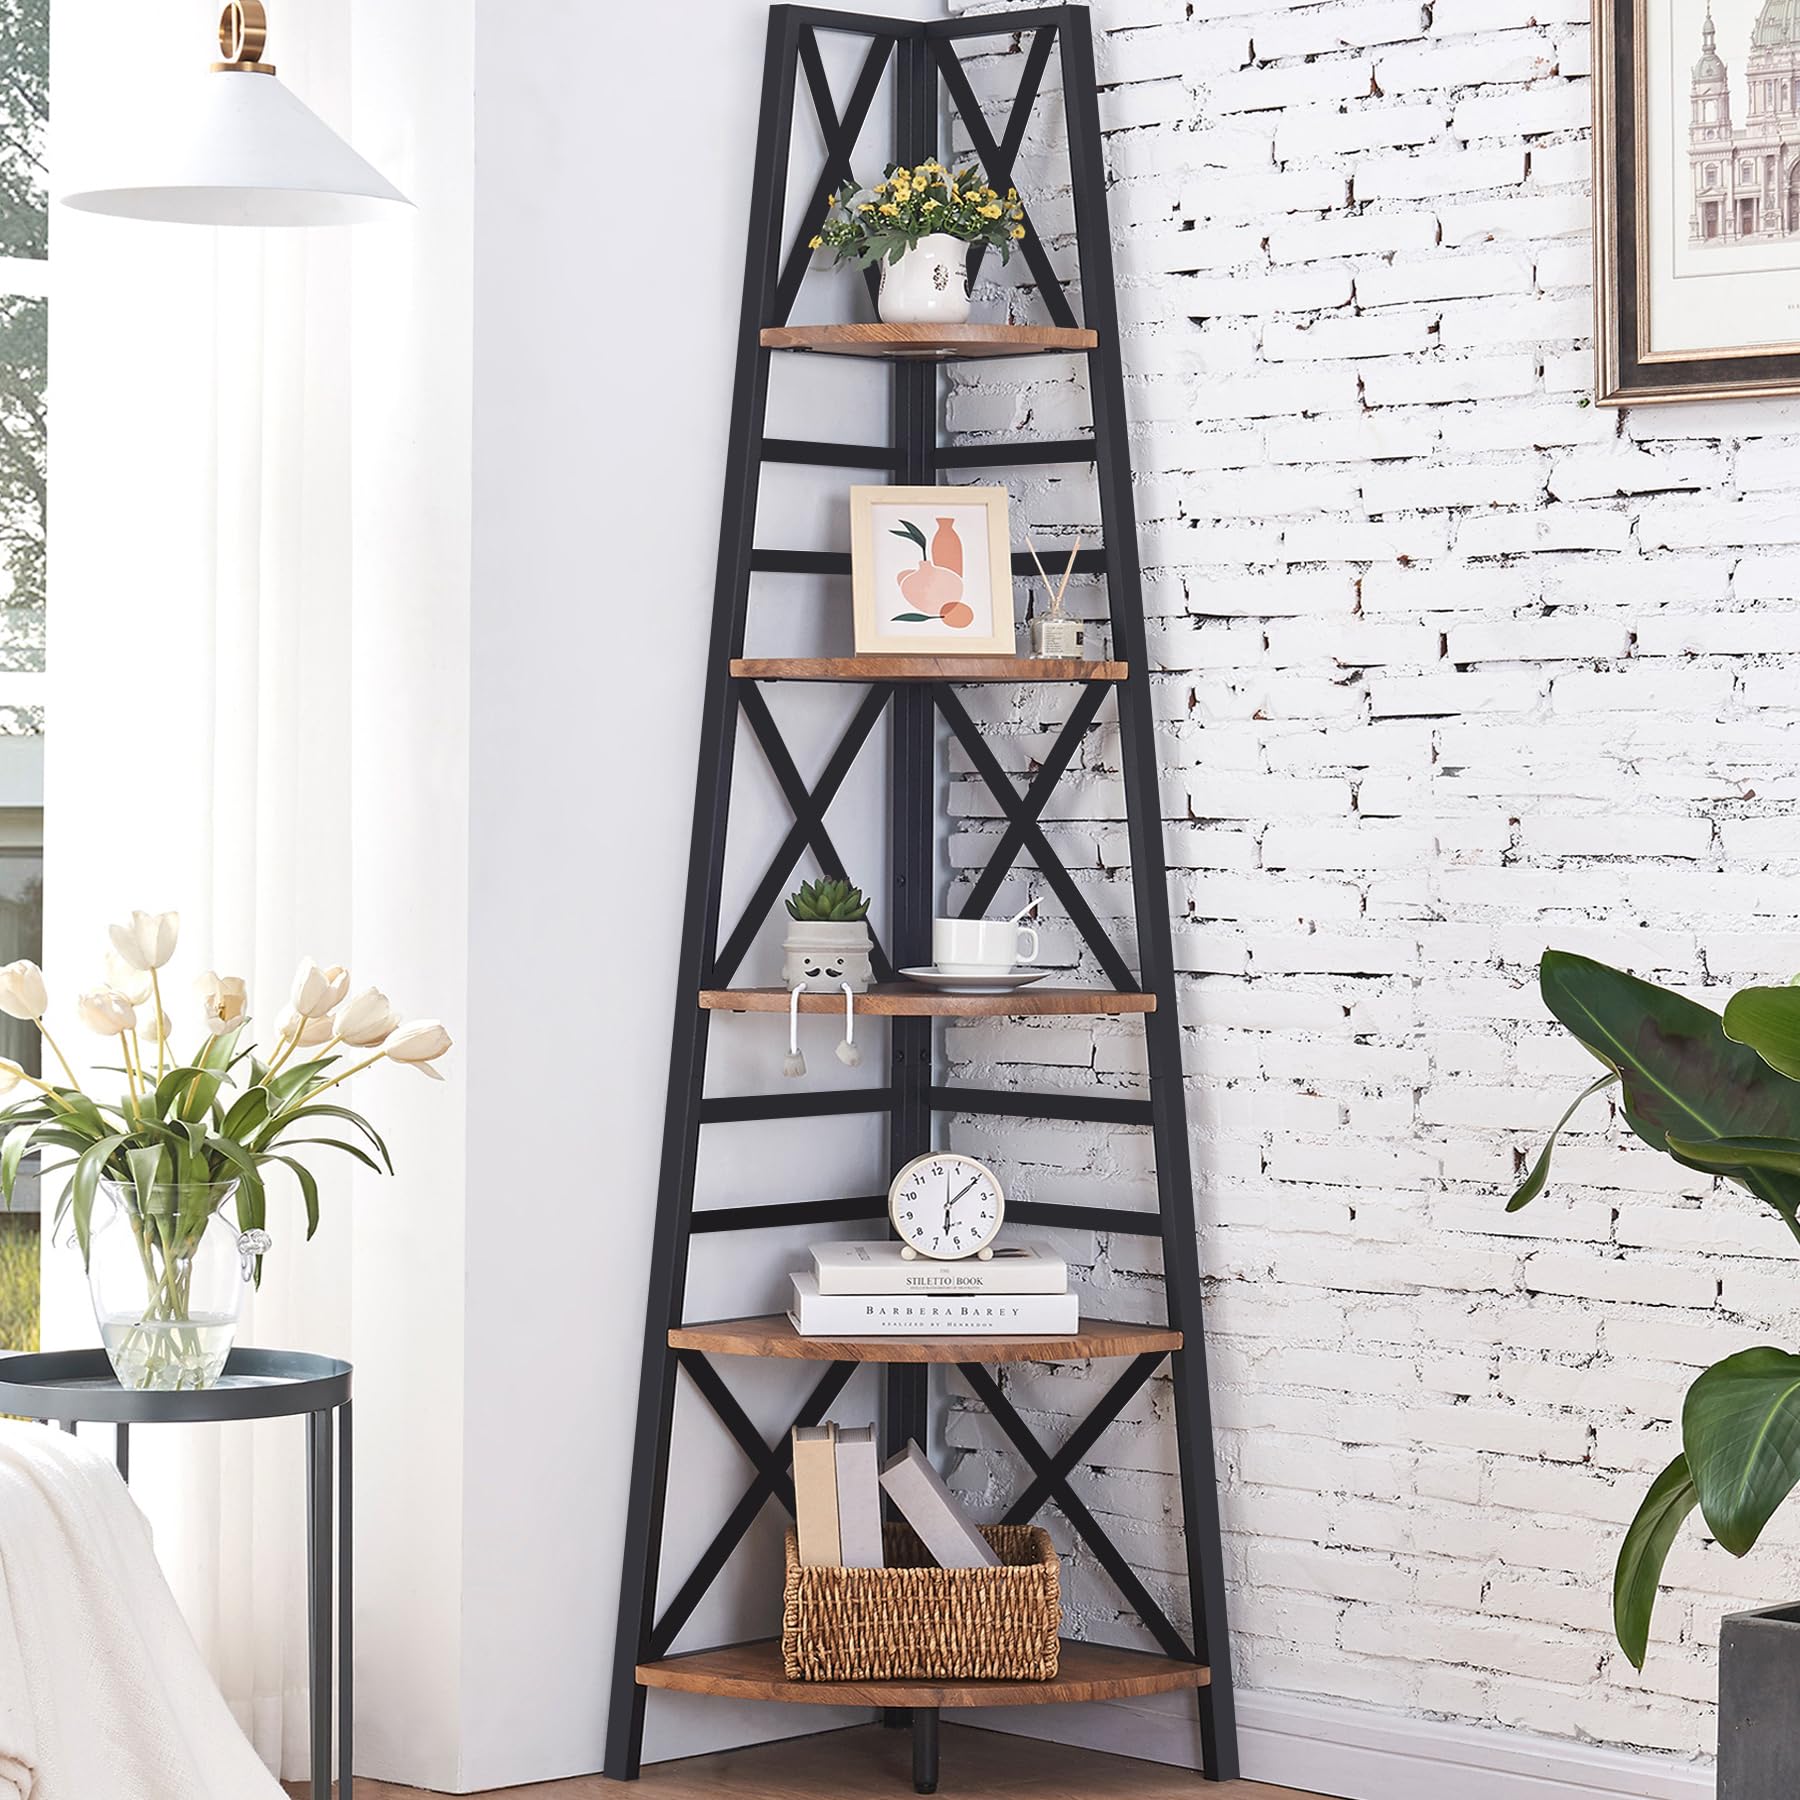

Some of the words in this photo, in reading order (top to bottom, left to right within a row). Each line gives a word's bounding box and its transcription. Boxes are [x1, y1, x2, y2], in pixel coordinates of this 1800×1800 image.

[931, 1166, 944, 1177] 12
[955, 1167, 961, 1175] 1
[915, 1176, 926, 1186] 11
[970, 1176, 978, 1185] 2
[905, 1191, 917, 1201] 10
[980, 1192, 988, 1201] 3
[906, 1211, 914, 1220] 9
[980, 1211, 987, 1219] 4
[916, 1227, 924, 1236] 8
[971, 1227, 977, 1236] 5
[933, 1237, 939, 1246] 7
[953, 1236, 961, 1245] 6
[905, 1277, 952, 1285] STILETTO
[956, 1277, 983, 1285] BOOK
[866, 1306, 952, 1316] BARBERA
[961, 1307, 1020, 1316] BAREY
